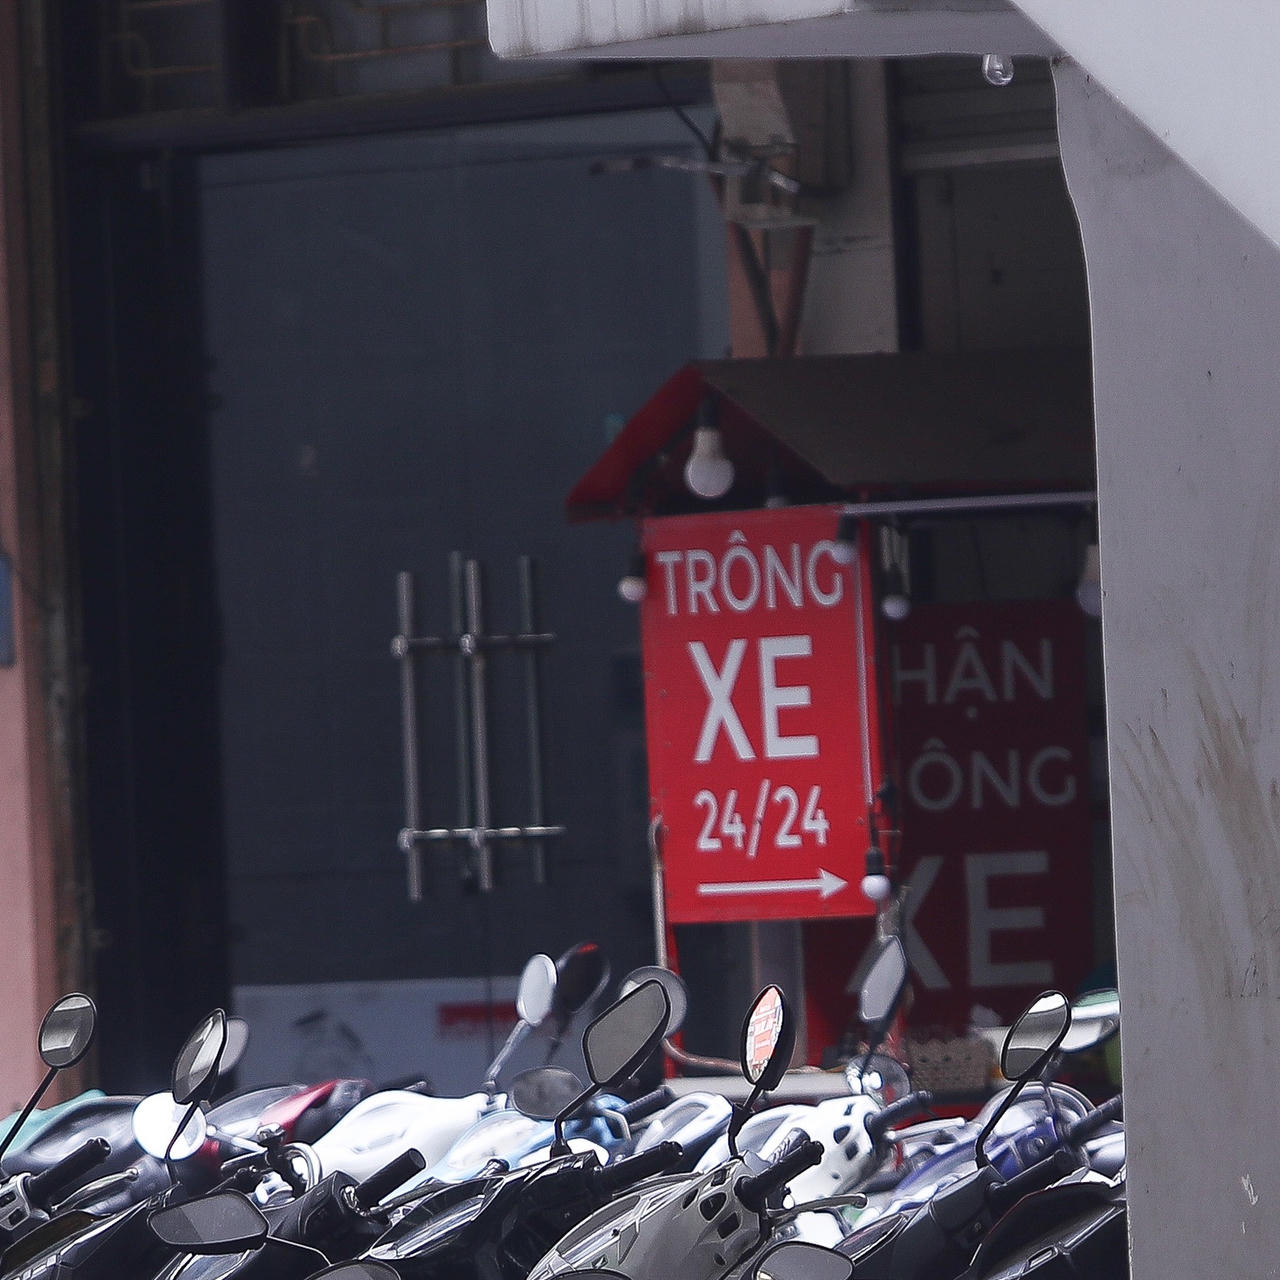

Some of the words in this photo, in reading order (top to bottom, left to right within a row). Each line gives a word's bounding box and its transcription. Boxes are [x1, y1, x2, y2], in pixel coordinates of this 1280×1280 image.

[655, 529, 845, 616] TRÔNG
[687, 634, 820, 763] XE
[891, 625, 1056, 720] HẬN
[693, 778, 831, 860] 24/24
[908, 737, 1078, 811] ÔNG
[845, 850, 1057, 991] XE
